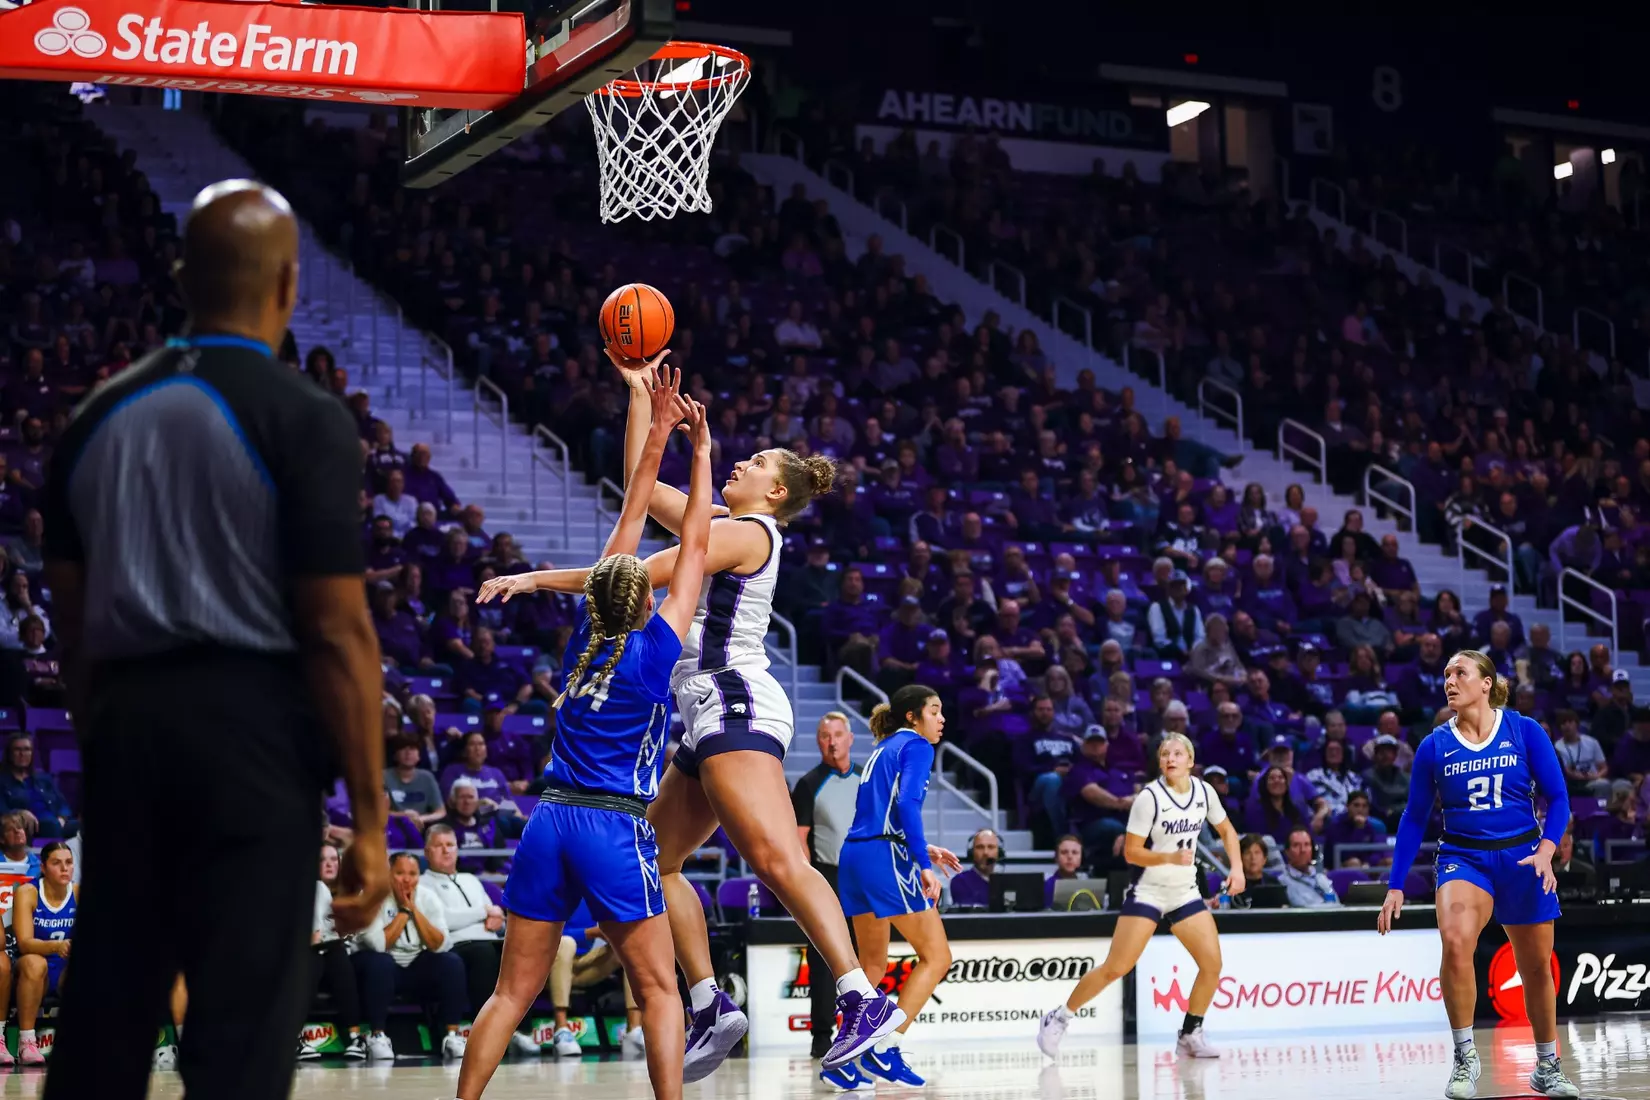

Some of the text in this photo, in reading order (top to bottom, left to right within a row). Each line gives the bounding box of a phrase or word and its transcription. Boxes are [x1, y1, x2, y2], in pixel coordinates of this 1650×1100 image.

[1372, 64, 1402, 113] 8
[619, 304, 633, 346] ELITE
[1444, 754, 1518, 777] CREIGHTON
[1467, 773, 1504, 811] 21
[33, 917, 76, 928] CREIGHTO
[1213, 976, 1368, 1009] SMOOTHIE
[1567, 952, 1650, 1006] Pizz
